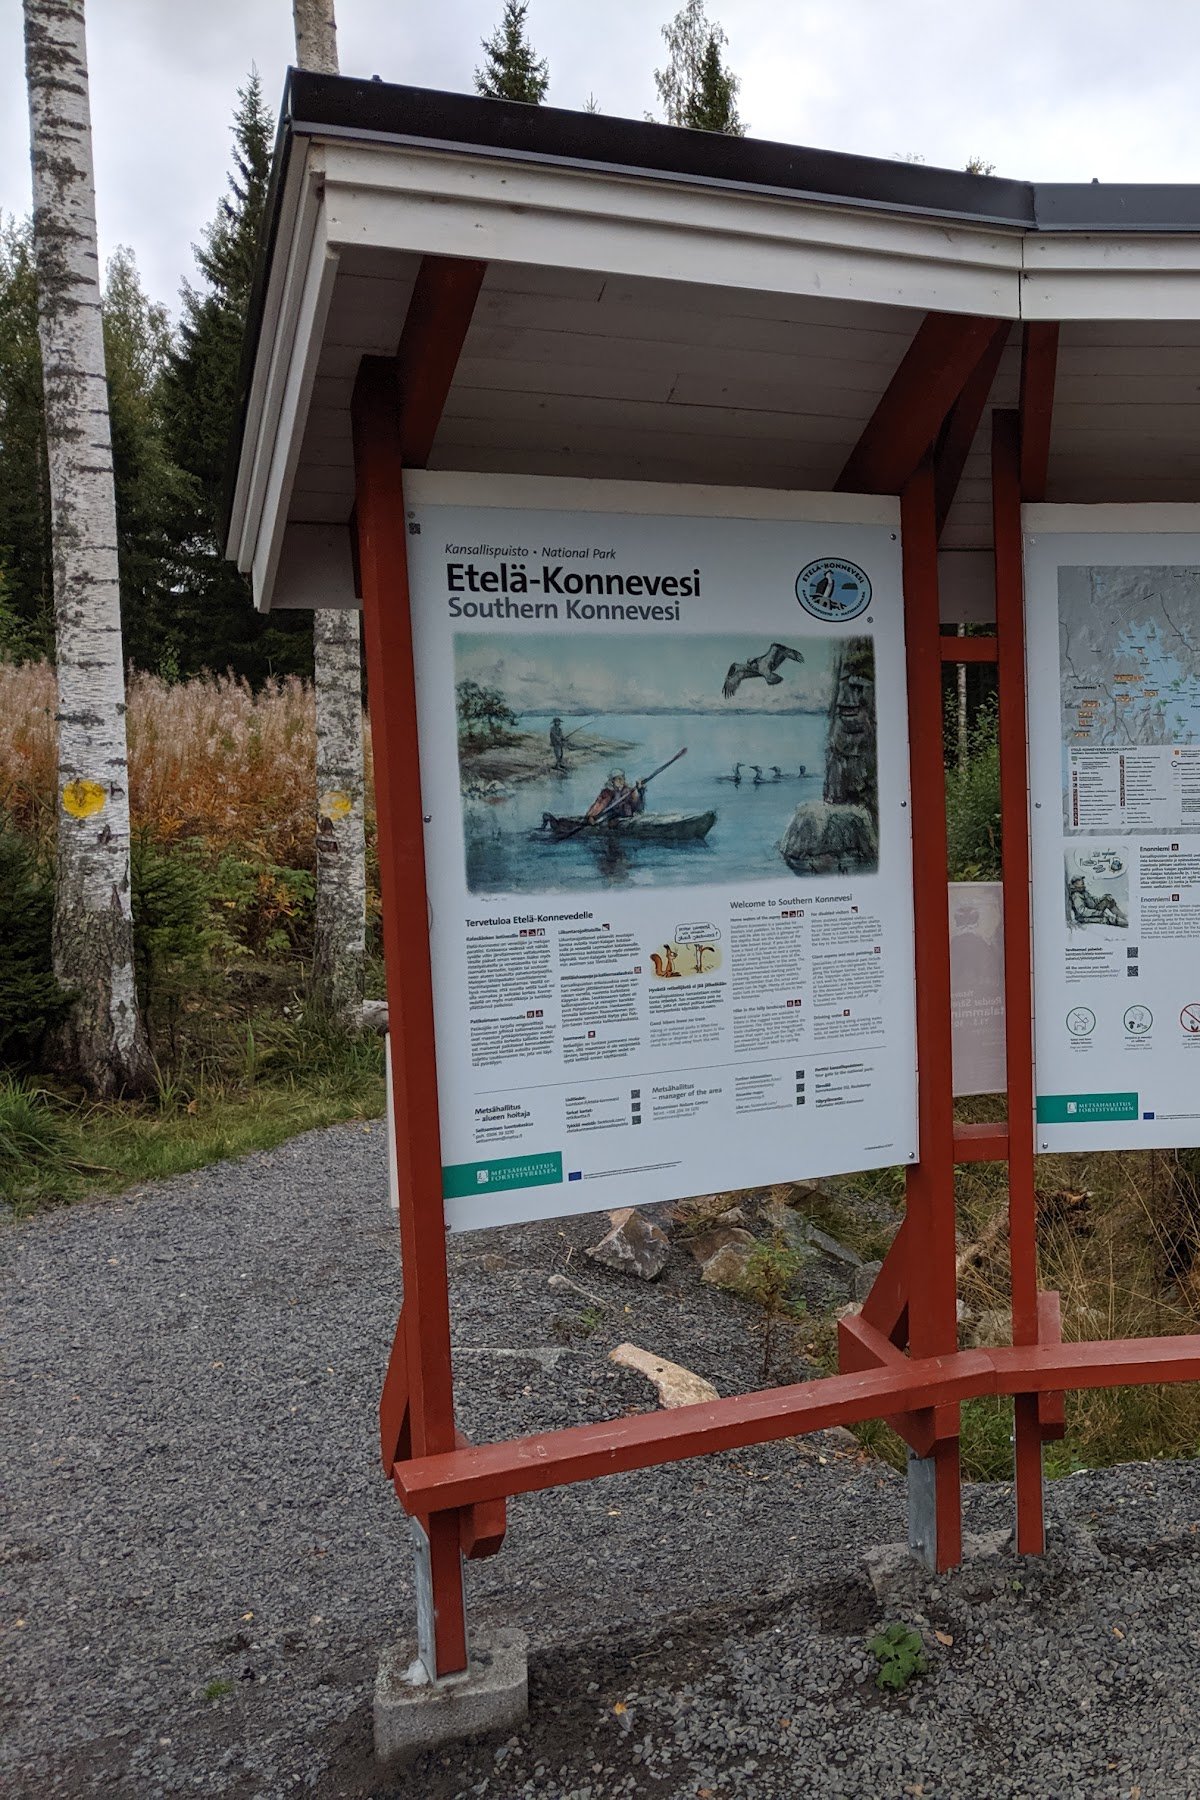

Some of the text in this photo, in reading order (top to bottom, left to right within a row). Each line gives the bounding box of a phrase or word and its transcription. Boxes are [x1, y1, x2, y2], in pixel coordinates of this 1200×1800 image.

[445, 544, 616, 560] Kansallispuisto National Park
[447, 563, 700, 596] Etelä-Konnevesi
[449, 597, 680, 620] Southern Konnevesi
[730, 900, 766, 908] Welcome
[778, 896, 812, 906] Southern
[816, 894, 852, 902] Konnevesi
[465, 911, 594, 927] Tervetuloa Etelä-Konnevedelle
[652, 1083, 694, 1093] Metsähallitus
[659, 1092, 686, 1102] manager
[474, 1103, 521, 1115] Metsähallitus
[482, 1111, 530, 1122] alueen hoitaja
